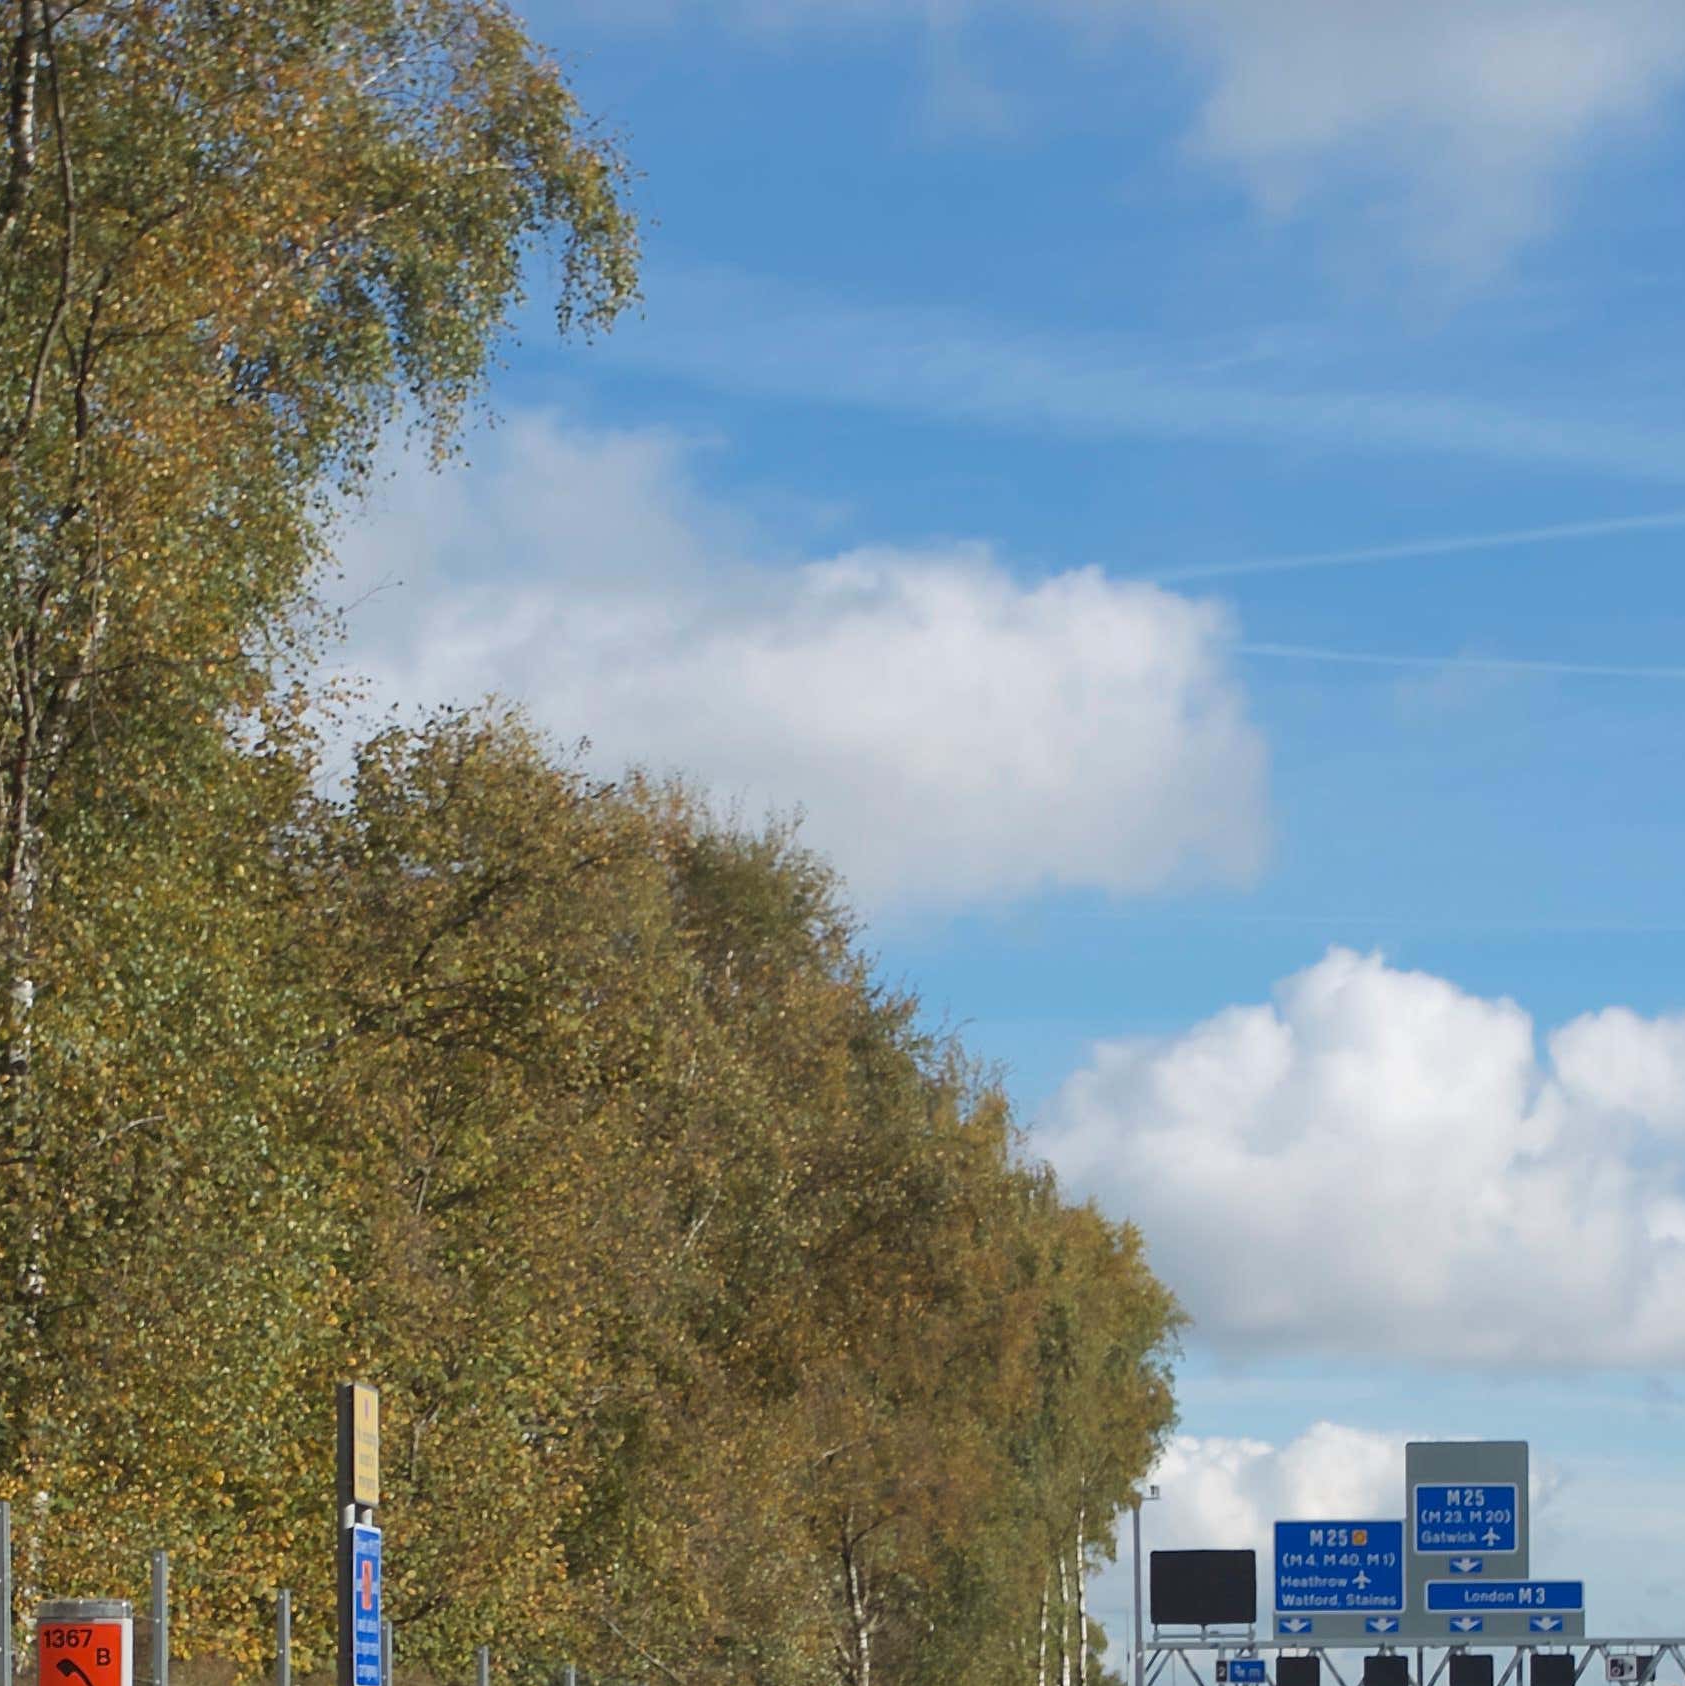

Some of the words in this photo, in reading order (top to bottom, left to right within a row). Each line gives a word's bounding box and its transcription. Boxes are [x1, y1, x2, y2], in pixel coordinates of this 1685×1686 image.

[1421, 1530, 1477, 1544] Gatwick
[1280, 1575, 1348, 1588] Heathrow
[1345, 1593, 1396, 1606] Staines
[1464, 1589, 1514, 1603] London
[43, 1628, 93, 1648] 1367
[96, 1647, 111, 1666] B
